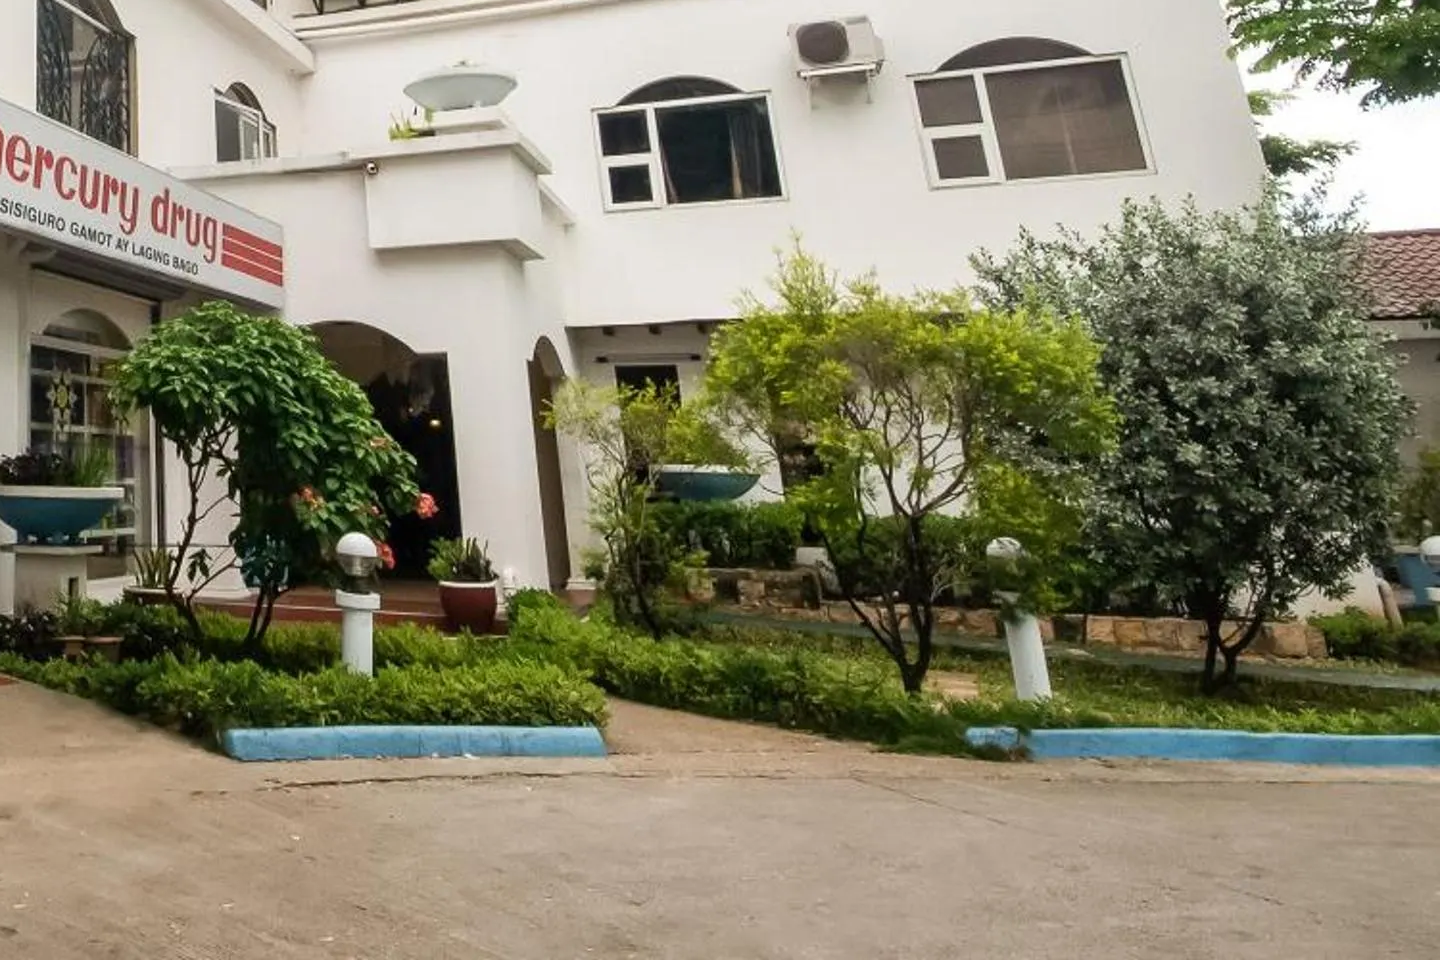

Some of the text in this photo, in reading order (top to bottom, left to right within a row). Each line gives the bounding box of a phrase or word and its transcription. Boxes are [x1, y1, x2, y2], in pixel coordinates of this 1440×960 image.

[70, 221, 113, 249] GAMOT
[115, 236, 129, 253] AY
[131, 244, 171, 268] LAGING
[171, 256, 199, 276] BAGO
[150, 187, 219, 264] drug
